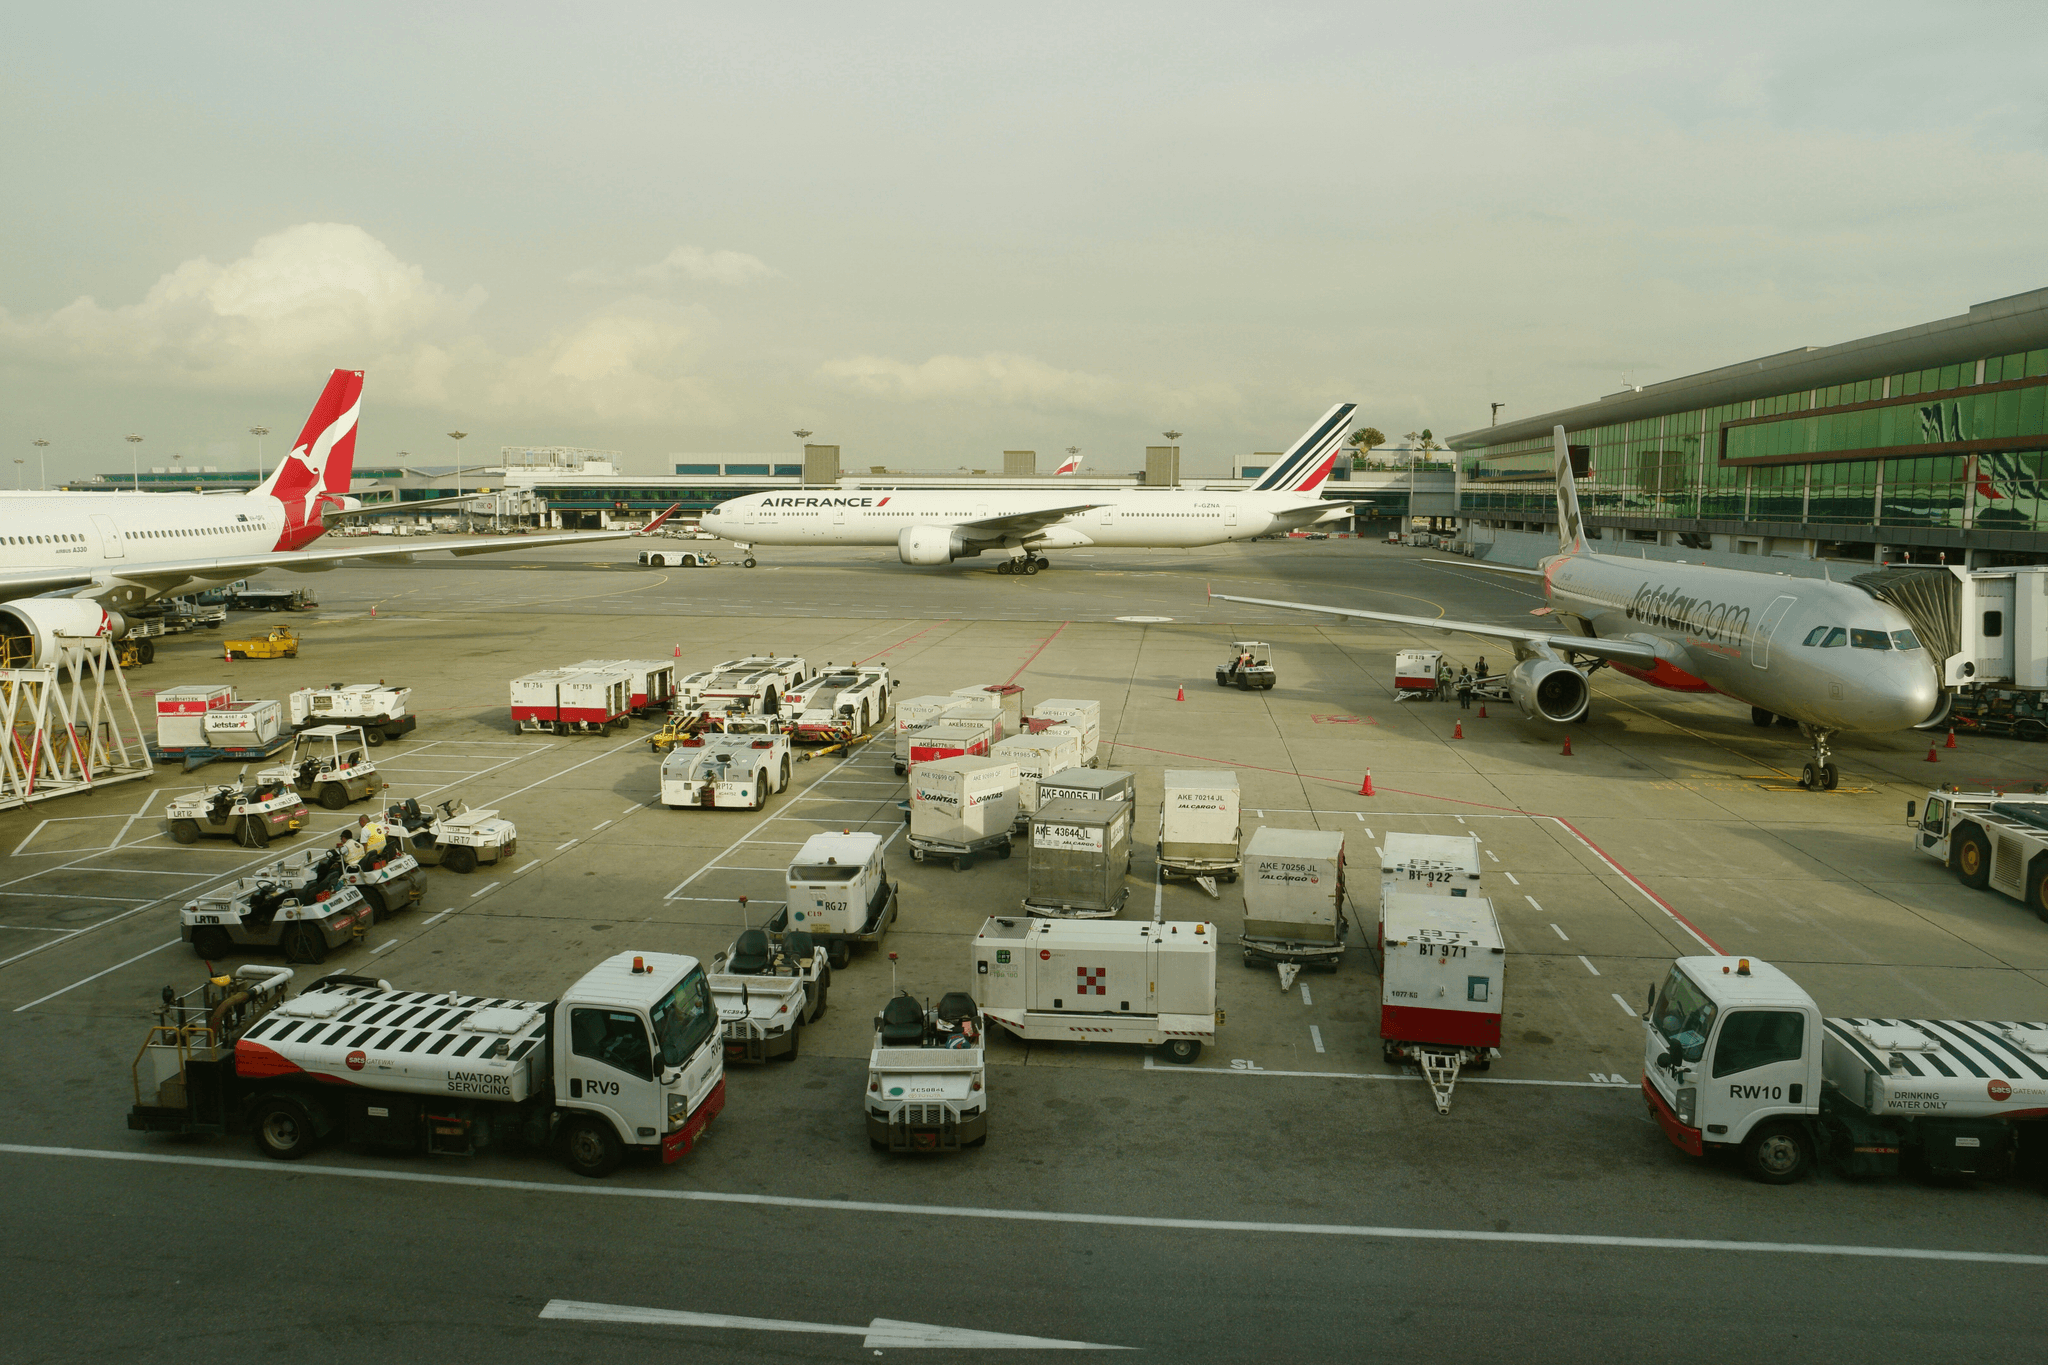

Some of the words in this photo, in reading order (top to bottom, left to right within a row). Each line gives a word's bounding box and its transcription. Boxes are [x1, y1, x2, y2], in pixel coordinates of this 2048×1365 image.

[761, 497, 872, 507] AIRFRANCE
[1626, 582, 1750, 646] Jetstar.com
[925, 793, 958, 804] QANTAS
[976, 792, 1003, 803] QANTAS
[1042, 788, 1057, 799] AKE
[1035, 826, 1051, 836] AKE
[1054, 828, 1079, 838] 43644
[1409, 870, 1422, 880] BT
[1429, 872, 1450, 882] 922
[826, 902, 836, 910] RG
[838, 902, 847, 910] 27
[1420, 944, 1435, 956] BT
[1442, 946, 1466, 958] 971
[447, 1071, 509, 1085] LAVATORY
[447, 1082, 510, 1096] SERVICING
[586, 1080, 620, 1096] RV9
[1730, 1085, 1782, 1100] RW10
[1894, 1091, 1939, 1100] DRINKING
[1888, 1100, 1919, 1109] WATER
[1920, 1101, 1948, 1110] ONLY
